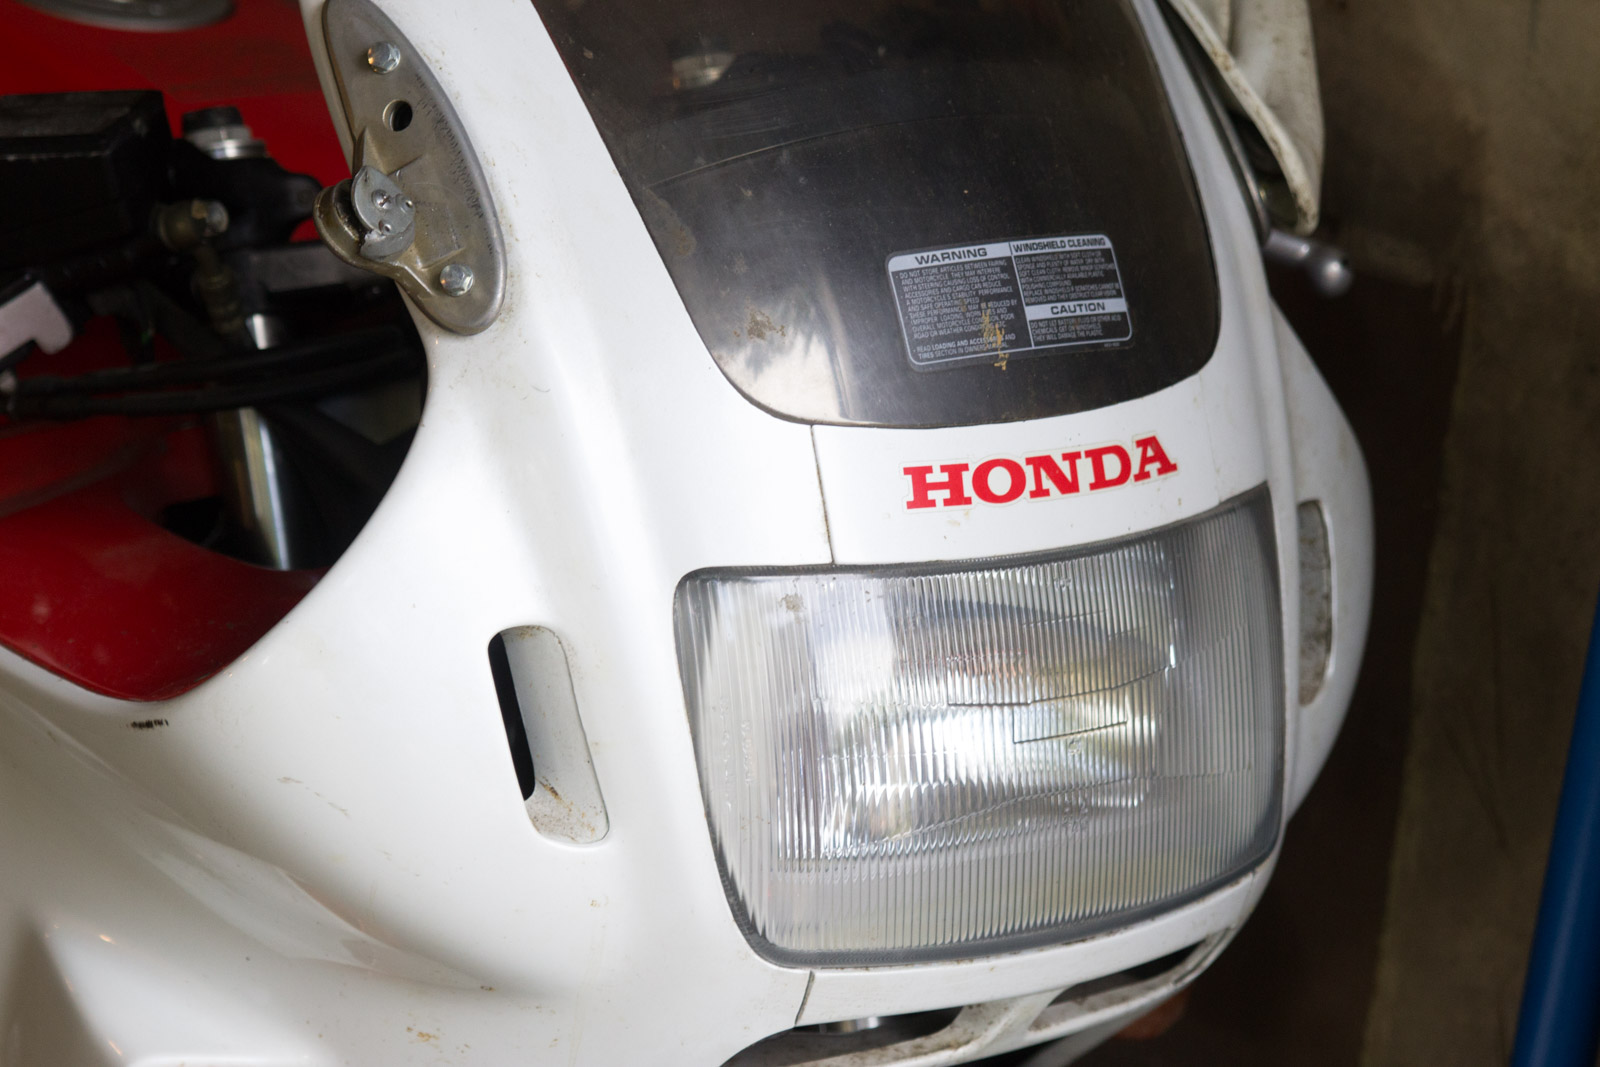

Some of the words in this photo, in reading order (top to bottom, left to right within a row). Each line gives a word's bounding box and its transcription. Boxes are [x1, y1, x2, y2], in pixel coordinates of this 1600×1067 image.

[1013, 241, 1066, 252] WINDSHIELD
[1067, 238, 1105, 248] CLEANING
[915, 248, 987, 265] WARNING
[922, 268, 939, 276] STORE
[940, 265, 963, 273] ARTICLES
[965, 261, 987, 270] BETWEEN
[977, 267, 1001, 275] INTERFERE
[904, 289, 939, 299] ACCESSORIES
[982, 280, 1001, 288] REDUCE
[918, 281, 943, 290] STEERING
[944, 278, 967, 287] CAUSING
[967, 276, 980, 284] LOSS
[978, 286, 1013, 296] PERFORMANCE
[910, 311, 926, 319] THESE
[988, 300, 1010, 308] REDUCED
[1051, 302, 1106, 314] CAUTION
[912, 324, 935, 332] OVERALL
[913, 331, 929, 339] ROAD
[939, 327, 963, 336] WEATHER
[917, 345, 932, 353] READ
[935, 349, 957, 357] SECTION
[903, 435, 1178, 510] HONDA
